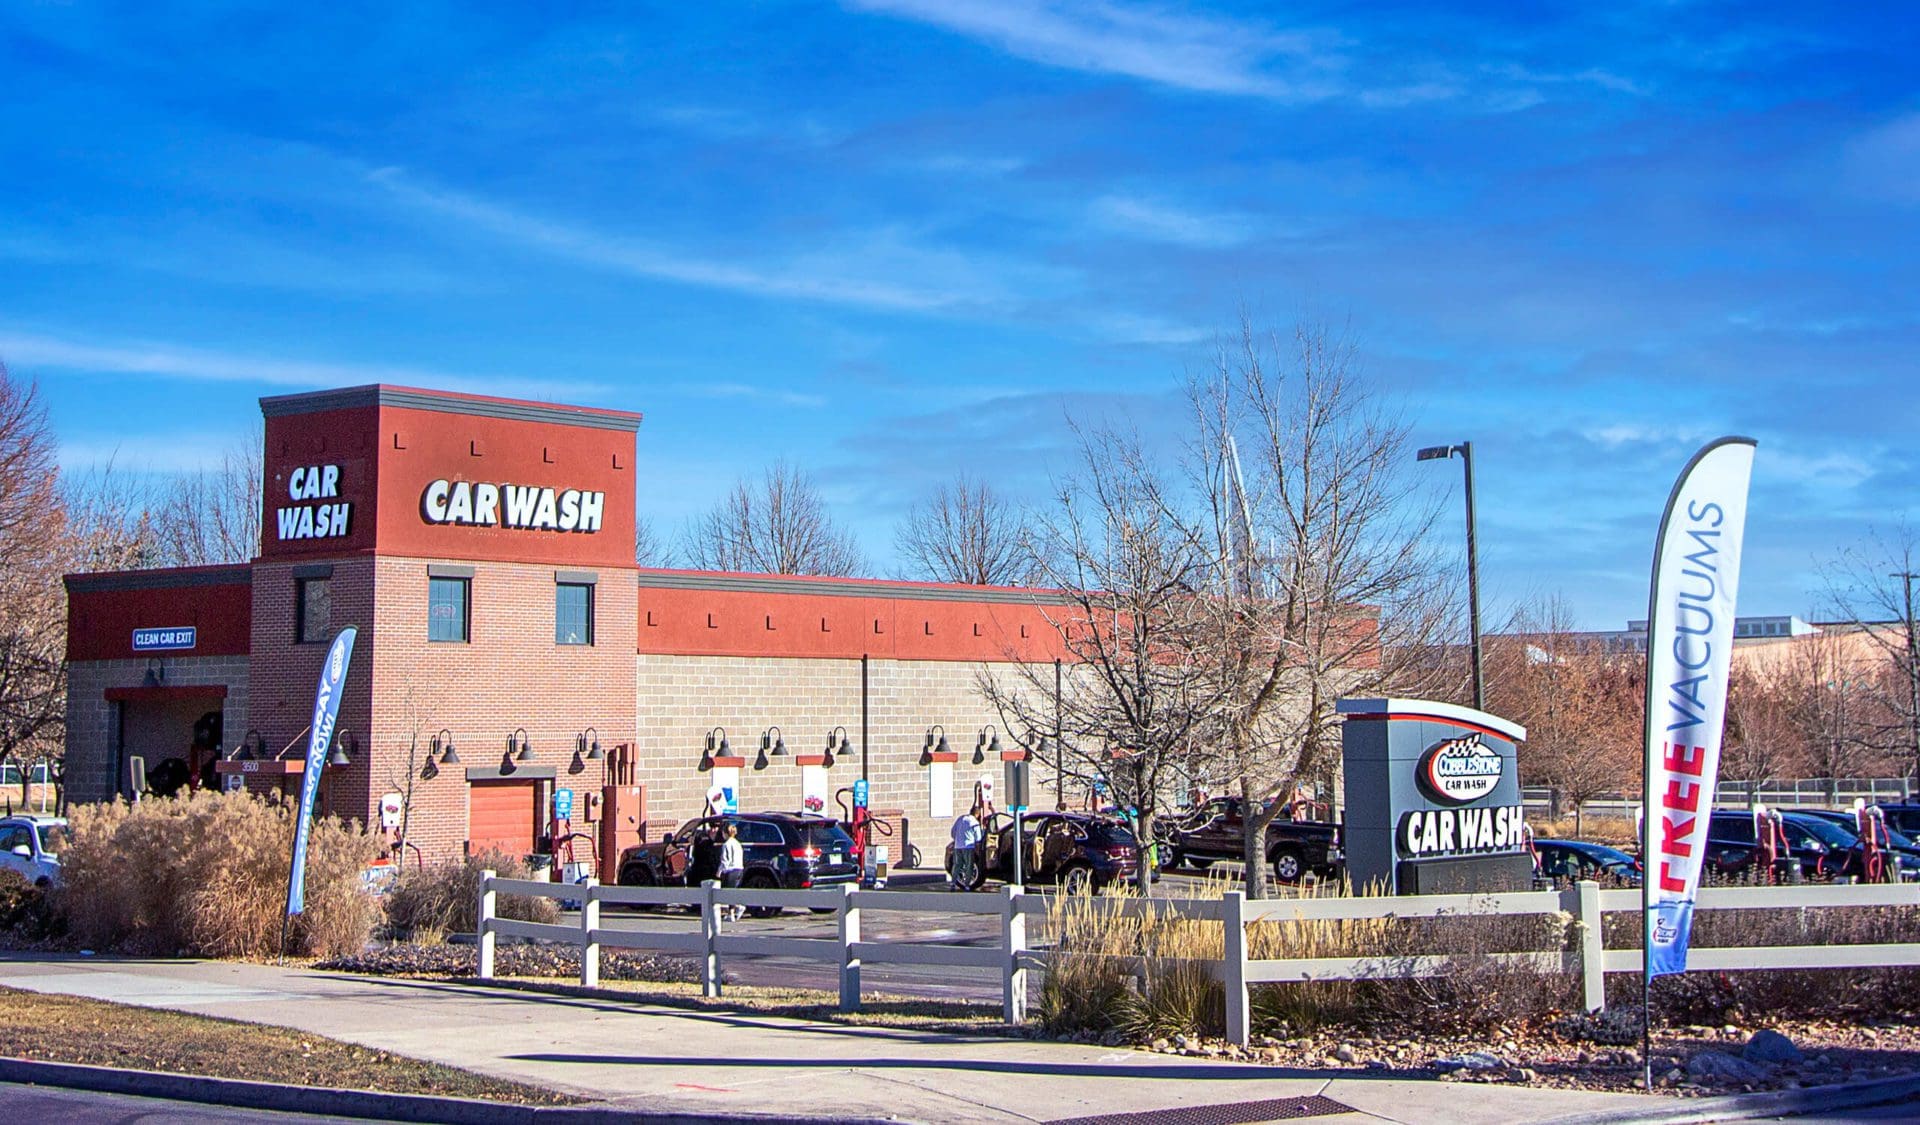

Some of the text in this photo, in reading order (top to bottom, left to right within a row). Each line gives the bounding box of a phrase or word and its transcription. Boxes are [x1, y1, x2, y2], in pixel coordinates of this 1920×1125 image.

[289, 465, 339, 500] CAR
[277, 503, 350, 540] WASH
[422, 479, 605, 533] CAR WASH
[136, 631, 193, 645] CLEAN CAR EXIT
[1659, 499, 1724, 894] FREE VACUUMS
[242, 761, 259, 772] 3500
[1446, 780, 1487, 790] CAR WASH
[1405, 806, 1523, 854] CAR WASH
